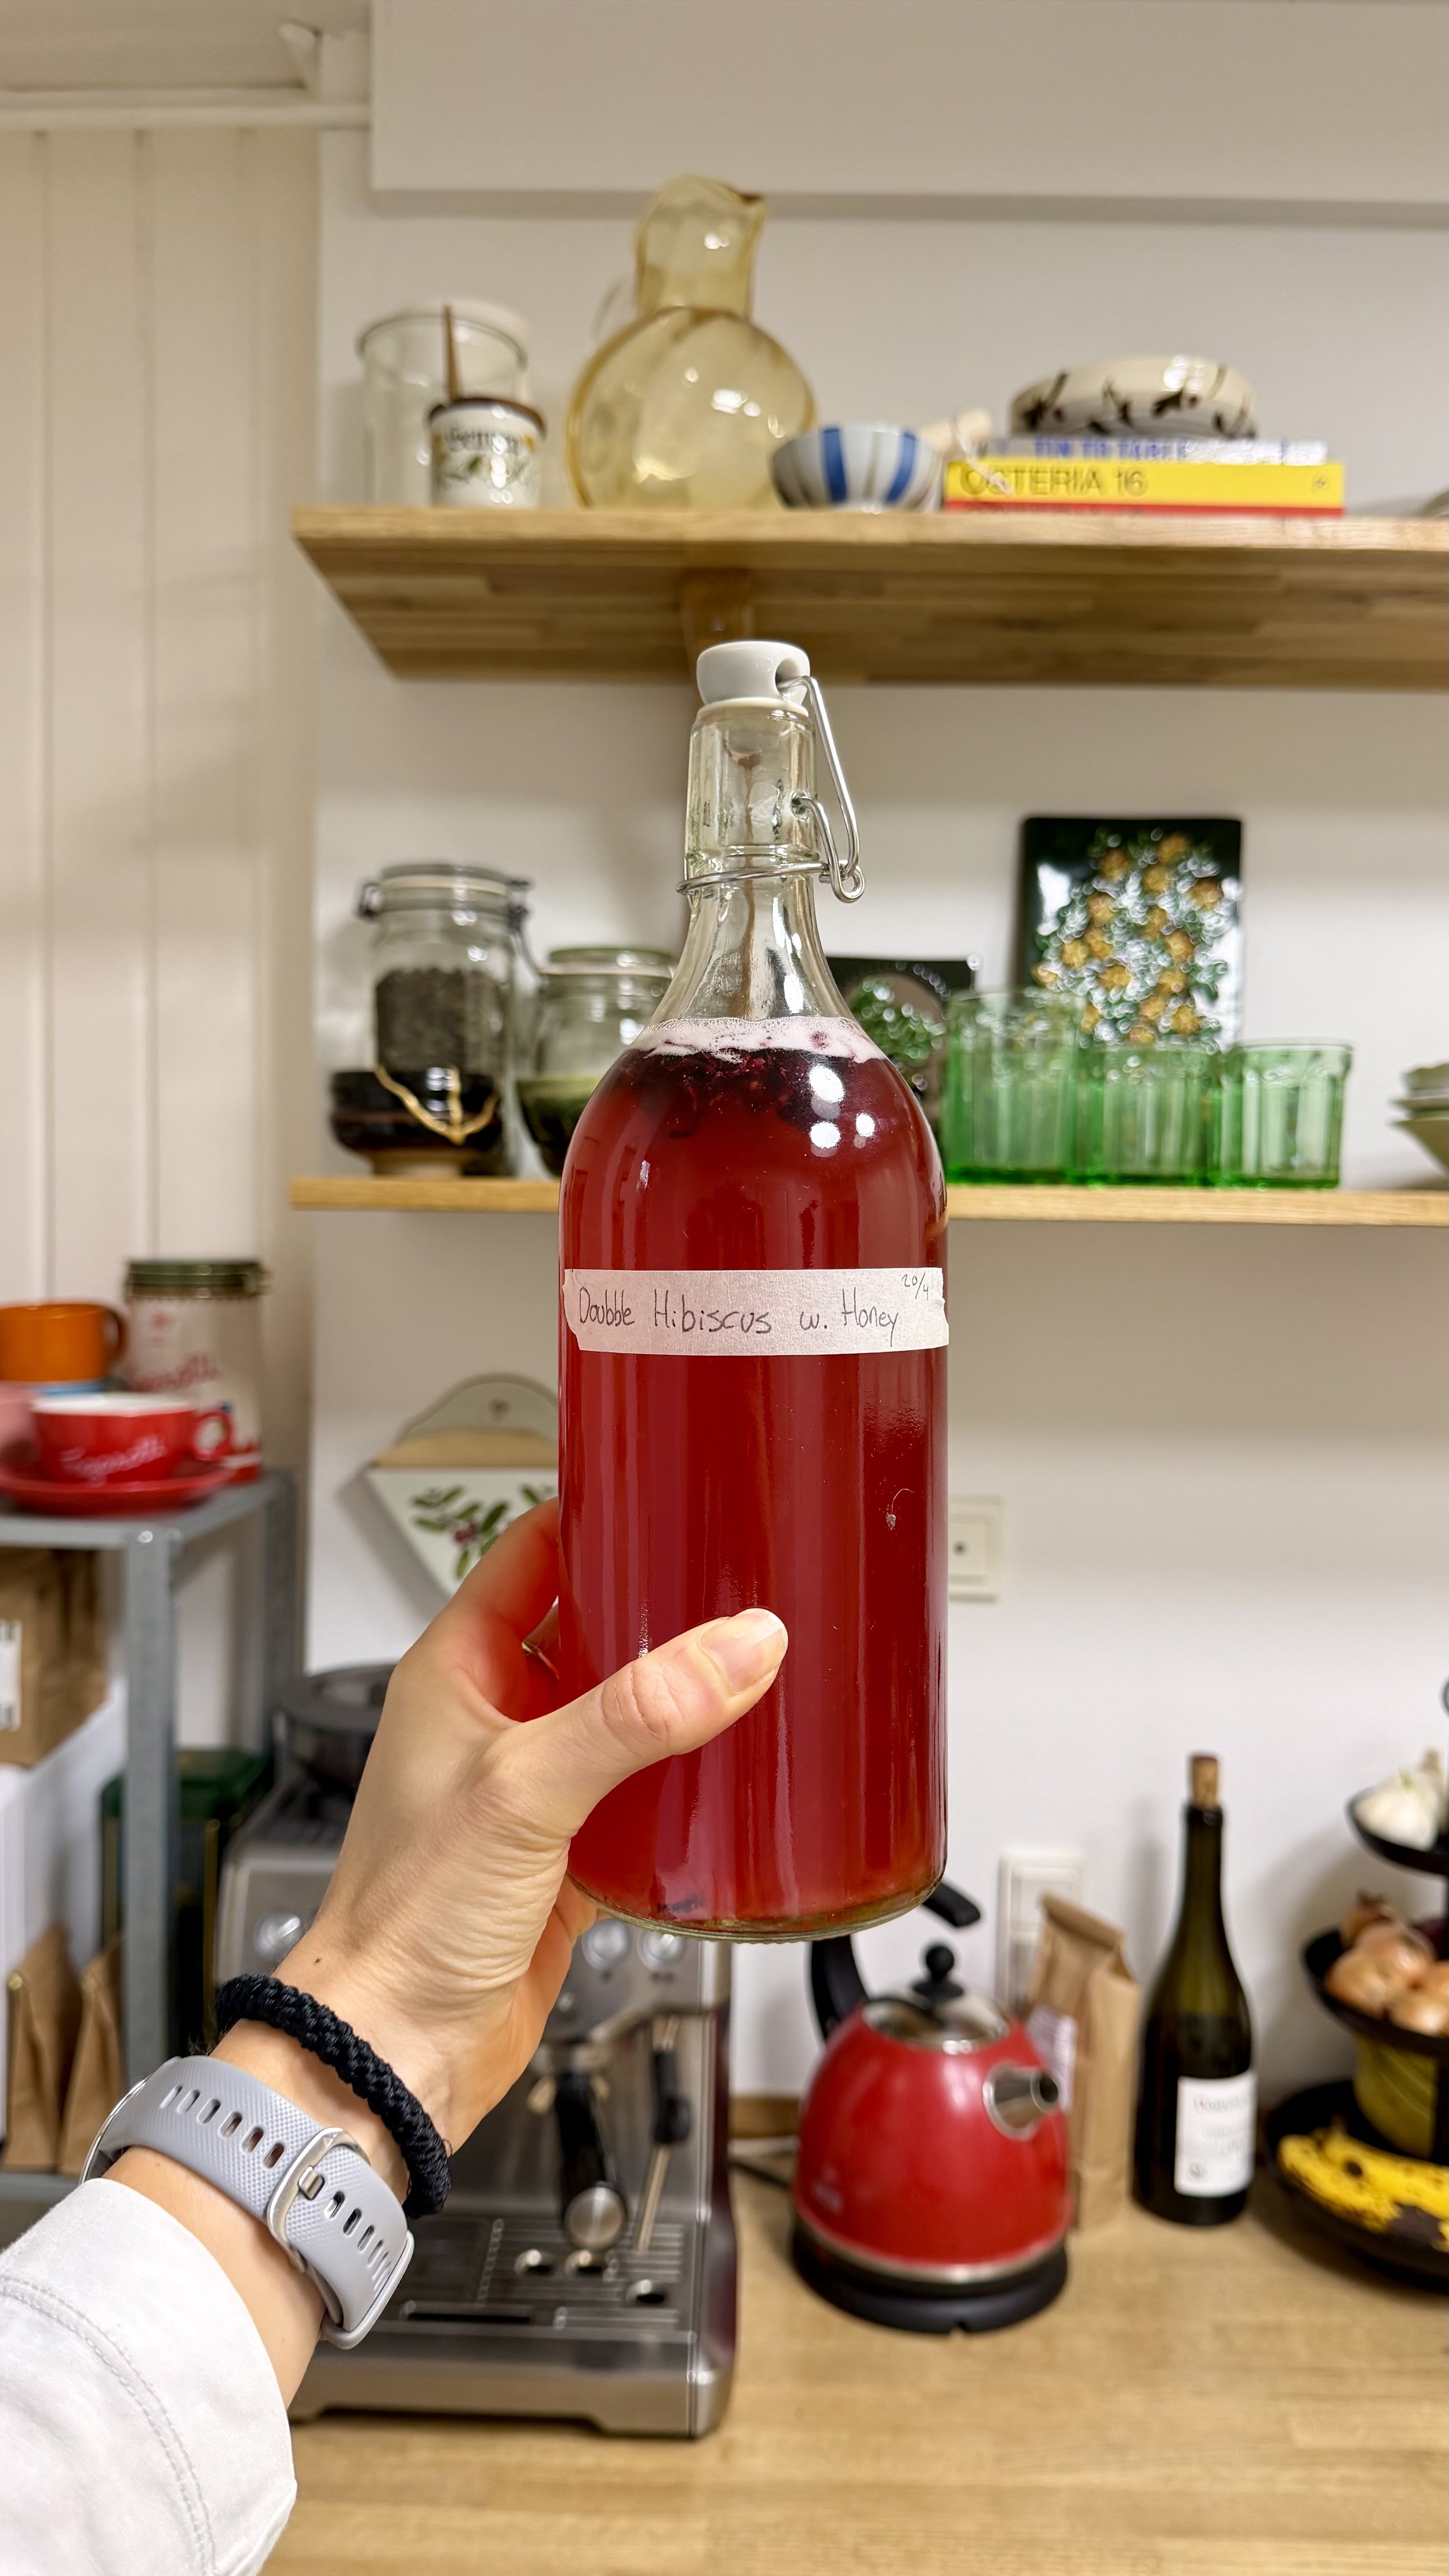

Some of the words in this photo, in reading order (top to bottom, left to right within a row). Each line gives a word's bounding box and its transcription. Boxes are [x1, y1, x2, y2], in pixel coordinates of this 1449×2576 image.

[960, 465, 1103, 495] OSTERIA
[902, 1271, 929, 1300] 20/4
[654, 1289, 772, 1334] Hibiscus
[800, 1311, 828, 1330] w.
[841, 1286, 898, 1348] Honey
